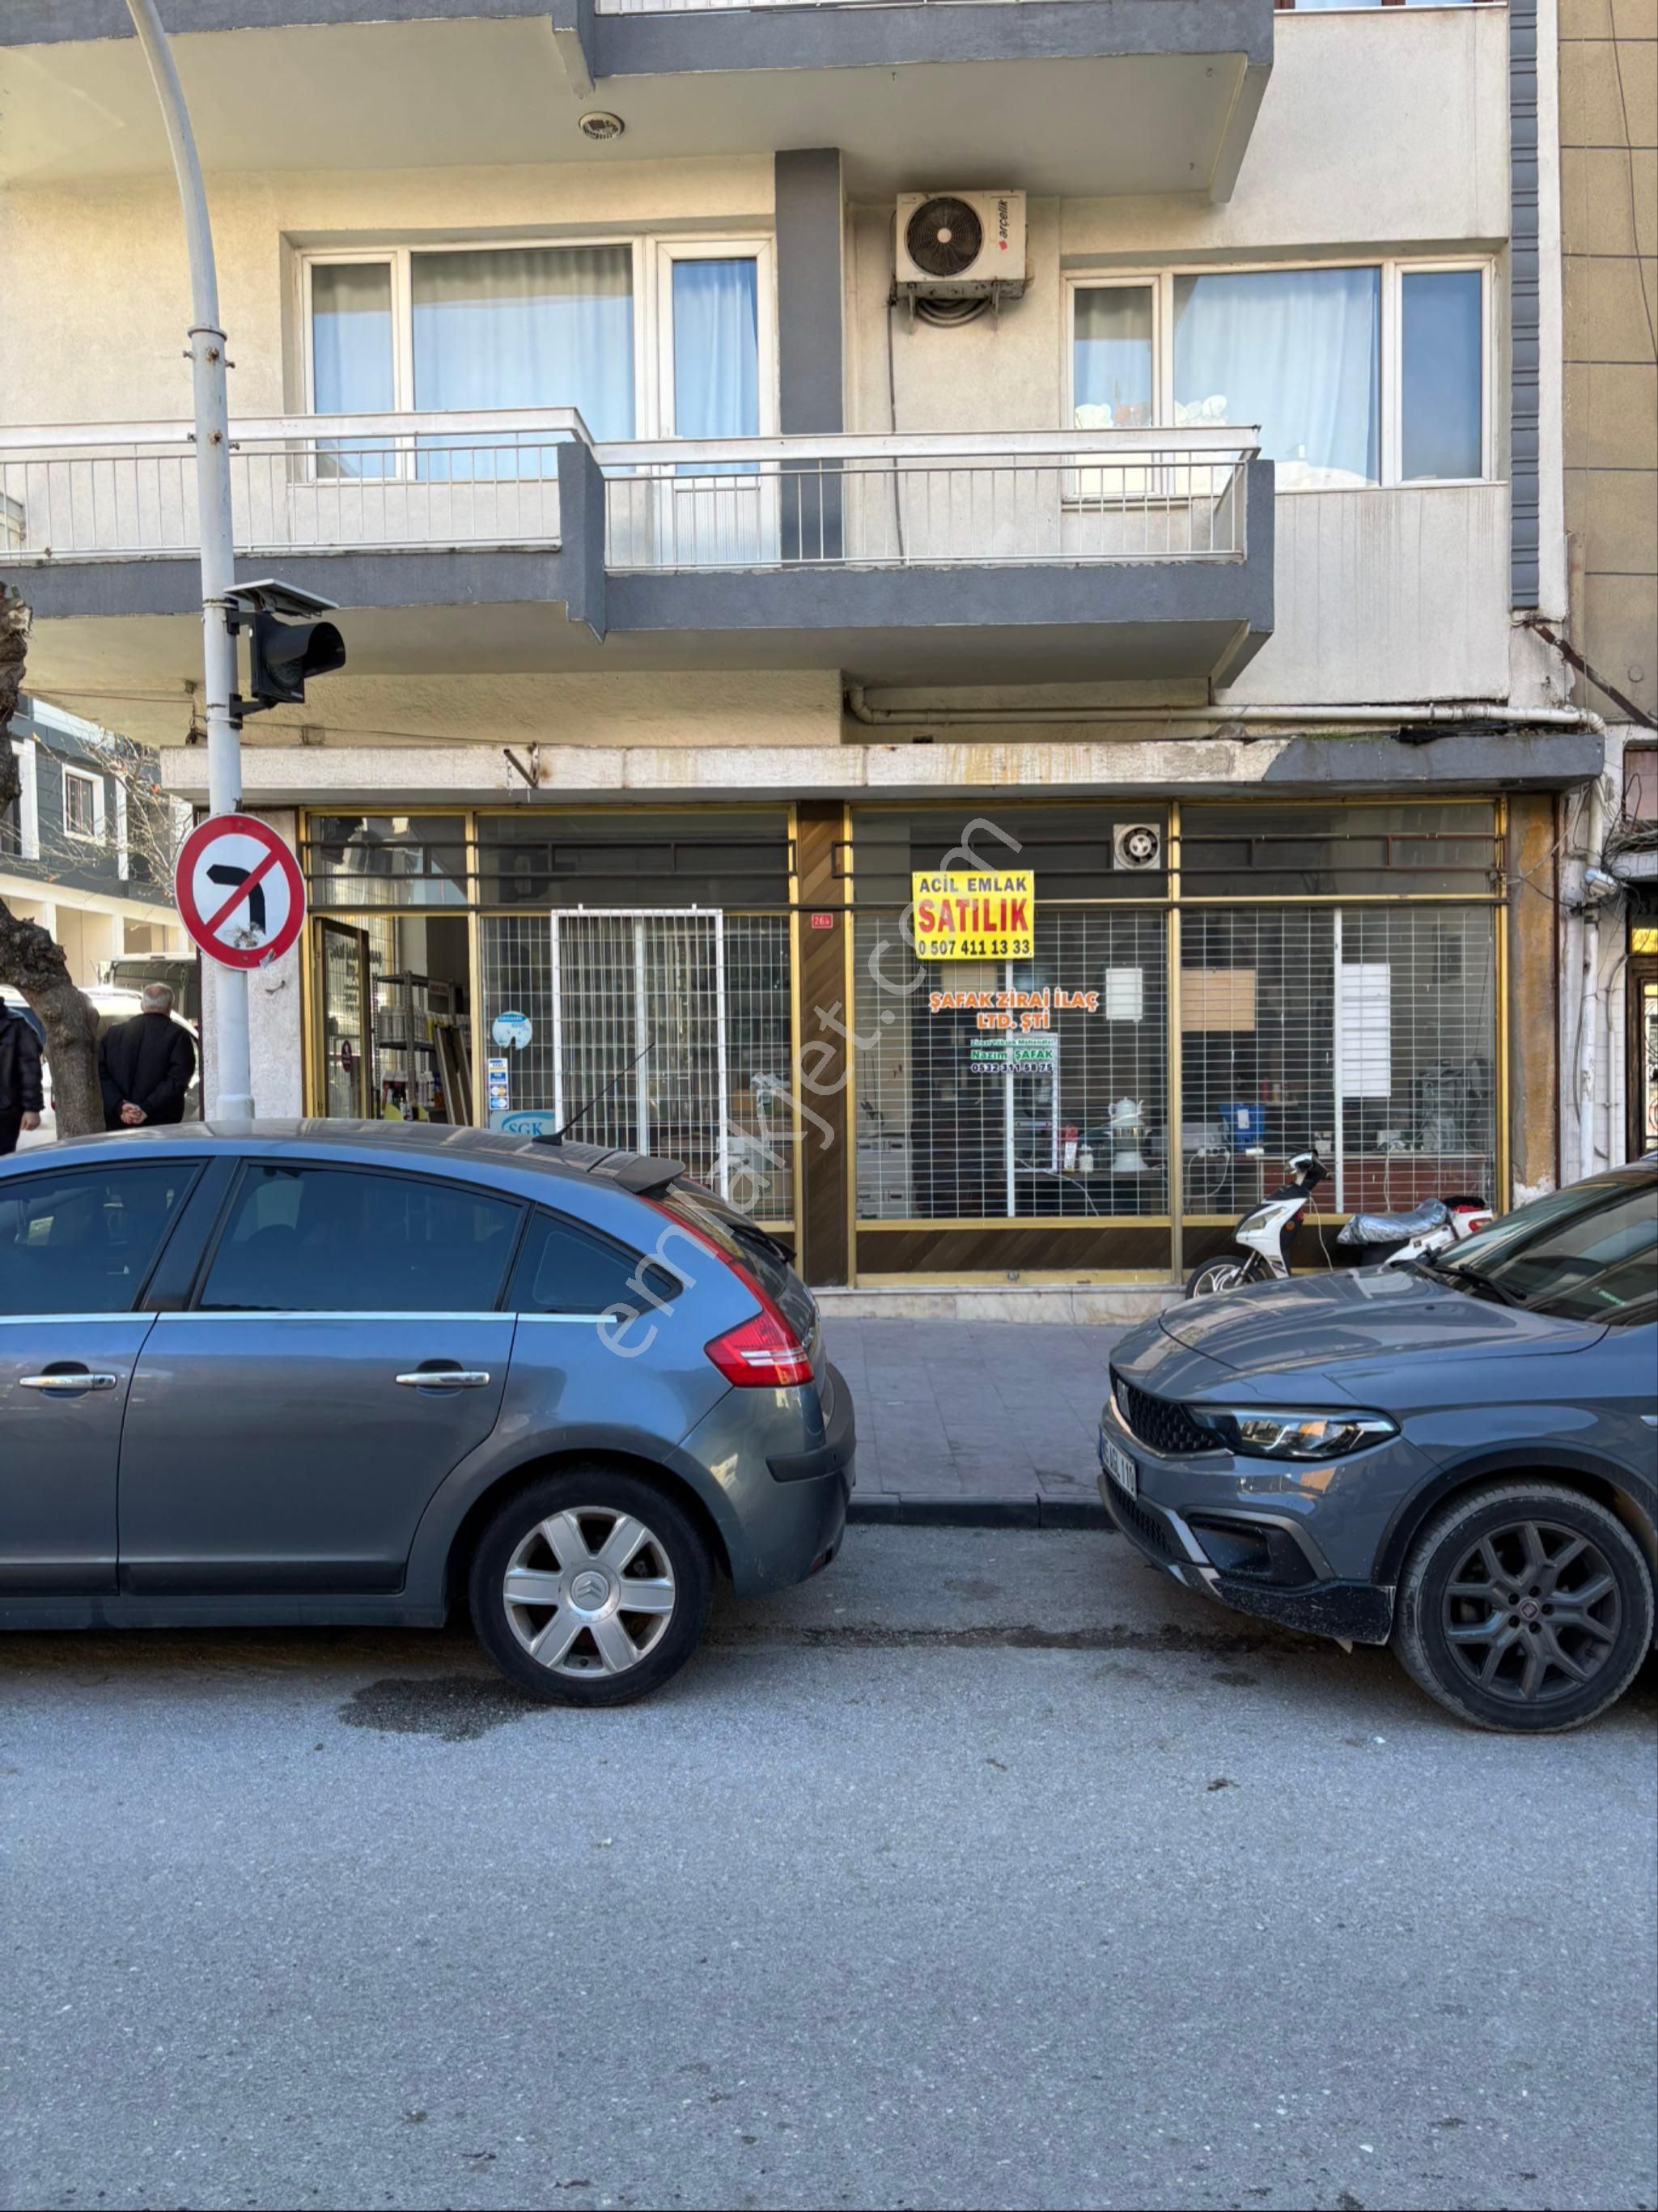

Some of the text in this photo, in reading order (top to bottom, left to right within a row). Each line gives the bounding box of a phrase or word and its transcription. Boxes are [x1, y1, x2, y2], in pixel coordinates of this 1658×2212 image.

[998, 199, 1010, 239] arçelik
[919, 875, 1027, 892] ACİL EMLAK
[918, 898, 1028, 932] SATILIK
[918, 939, 1030, 955] 0 507 411 13 33
[929, 987, 1100, 1012] ŞAFAK ZİRAİ İLAÇ
[976, 1008, 1051, 1033] LTD. ŞTİ
[1014, 1049, 1053, 1062] ŞAFAK
[971, 1064, 999, 1072] 0532
[1001, 1064, 1020, 1072] 311
[1039, 1064, 1053, 1072] 75
[508, 1122, 543, 1136] SGK
